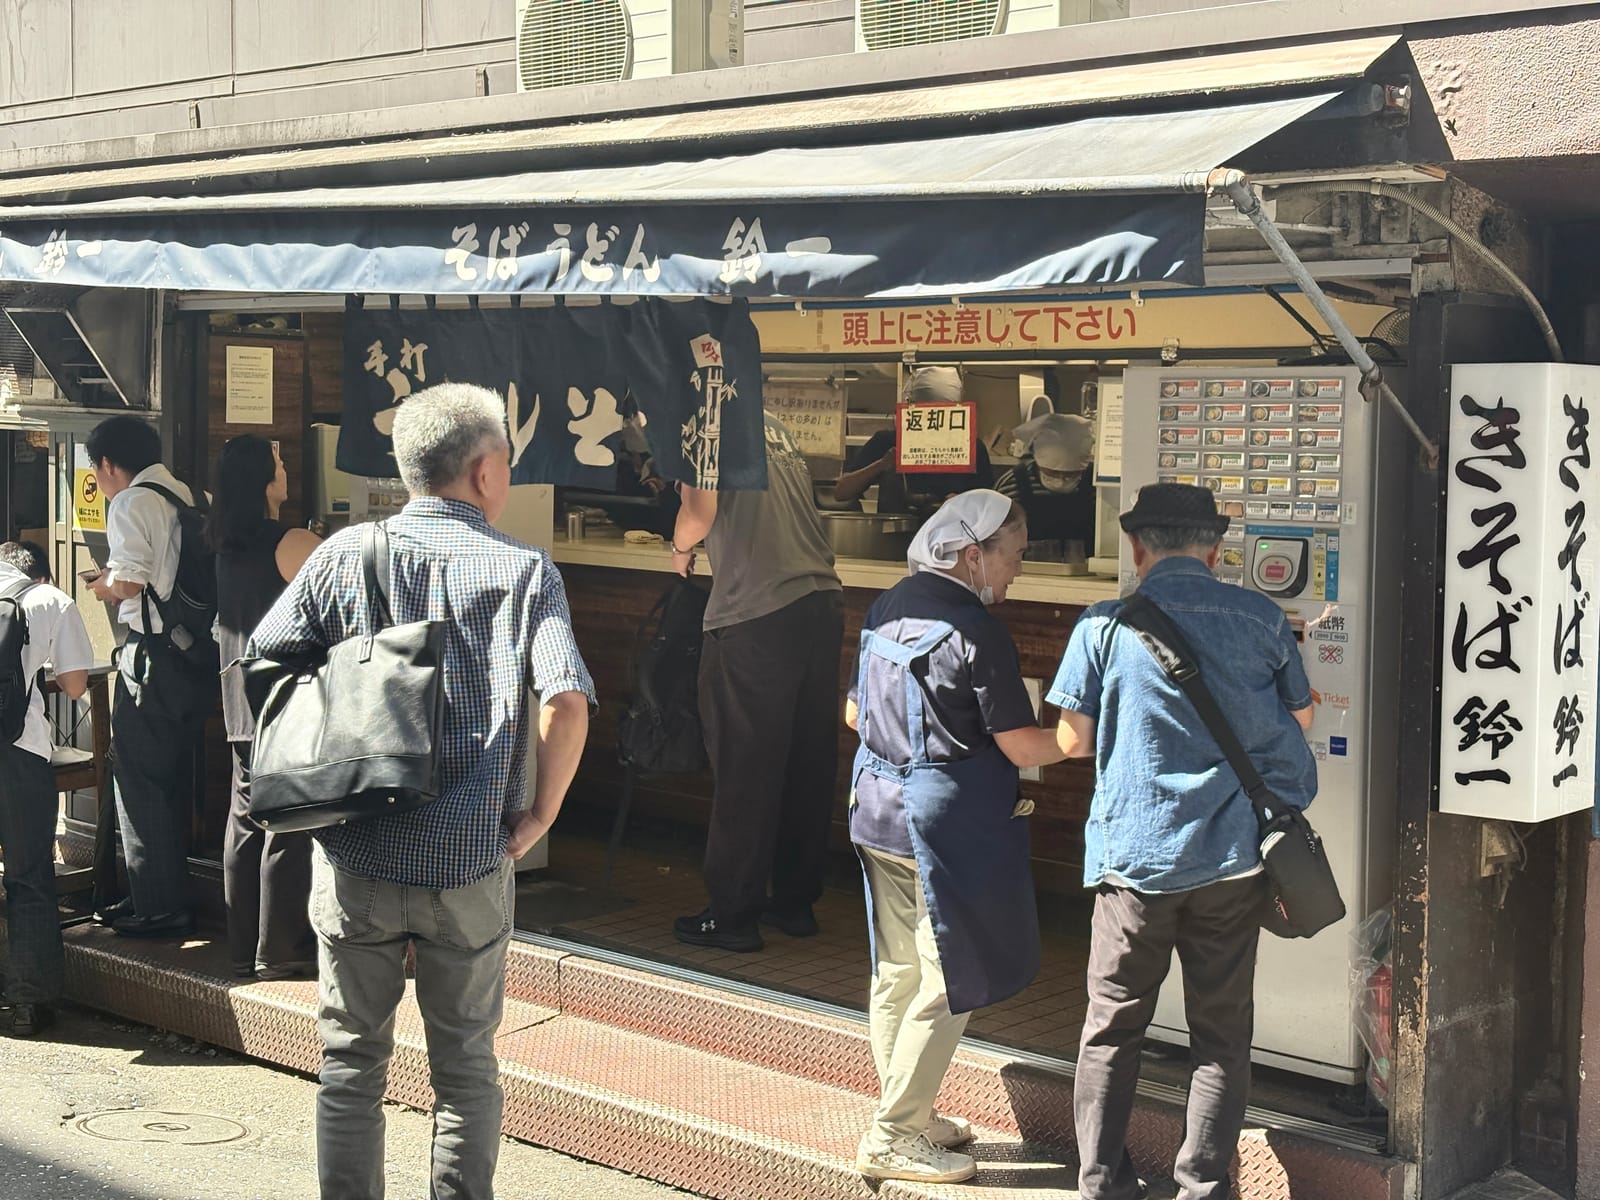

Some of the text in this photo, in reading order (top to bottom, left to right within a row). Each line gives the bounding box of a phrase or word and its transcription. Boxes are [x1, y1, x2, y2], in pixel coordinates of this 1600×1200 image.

[719, 216, 832, 284] 鈴一
[842, 306, 1136, 346] 頭上に注意して下さい
[364, 338, 428, 382] 手打
[763, 397, 840, 409] に申し訳ありませんが
[906, 409, 967, 431] 返却口
[1324, 692, 1350, 704] Ticket
[1452, 695, 1524, 786] 鈴一
[1552, 694, 1584, 788] 鈴一
